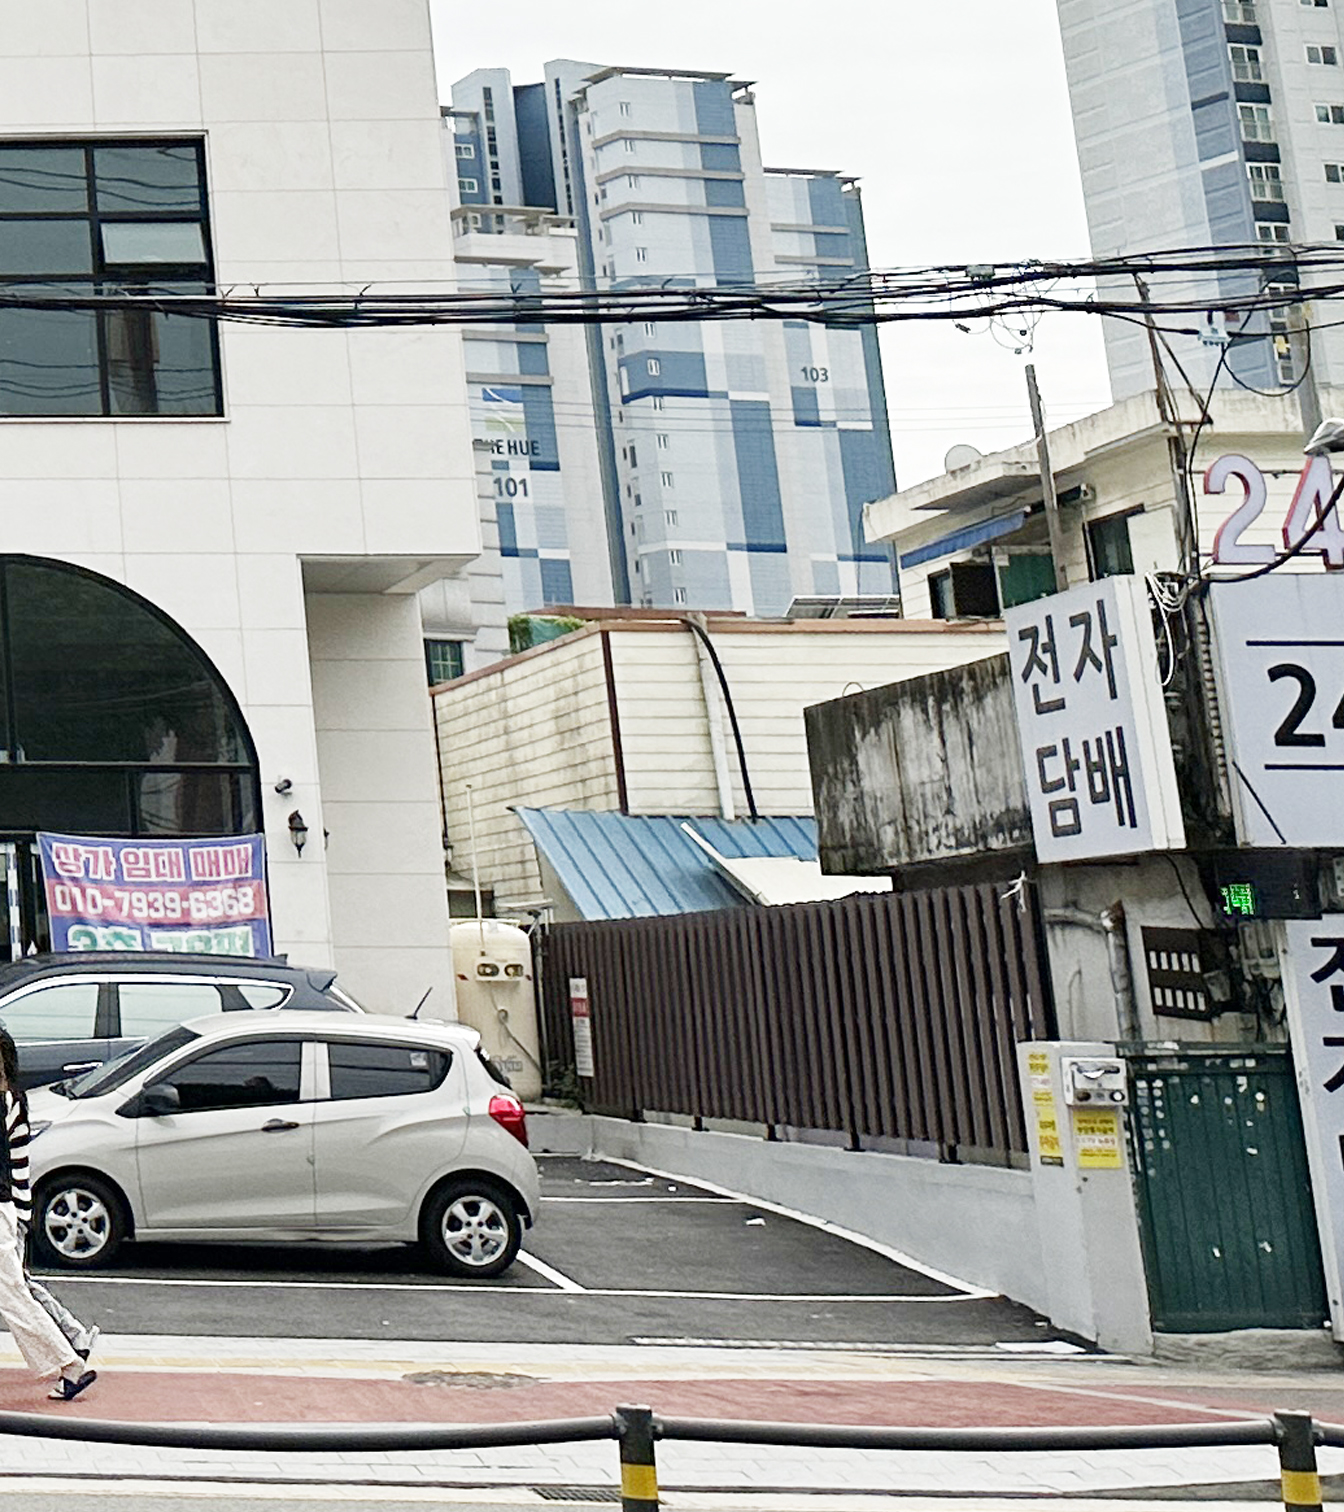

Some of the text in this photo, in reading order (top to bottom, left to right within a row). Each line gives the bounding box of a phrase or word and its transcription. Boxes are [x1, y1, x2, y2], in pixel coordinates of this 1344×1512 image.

[799, 366, 830, 384] 103
[507, 439, 542, 456] HUE
[493, 476, 529, 498] 101
[1203, 450, 1344, 572] 24
[1017, 599, 1119, 716] 전자
[1266, 662, 1344, 748] 2
[1035, 725, 1138, 838] 담배
[52, 843, 253, 882] 상가 임대 매매
[54, 885, 256, 919] 010-7939-6368
